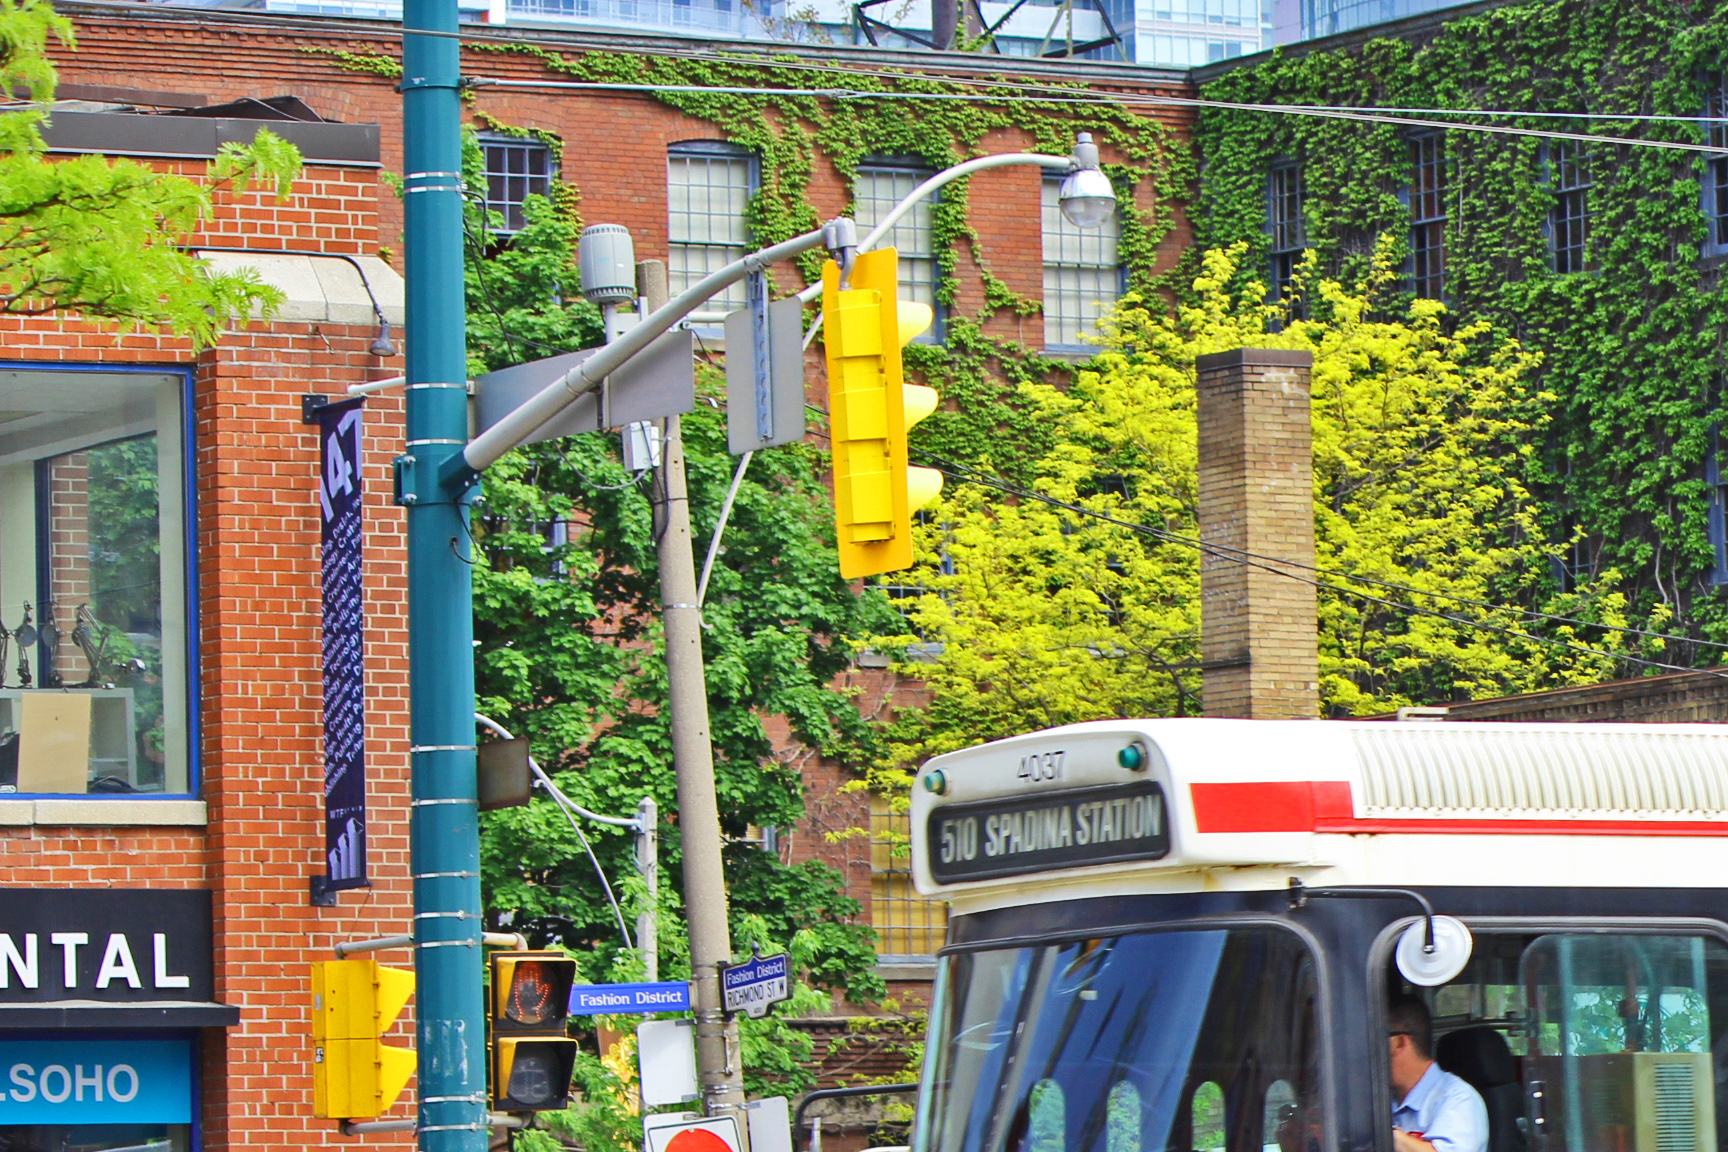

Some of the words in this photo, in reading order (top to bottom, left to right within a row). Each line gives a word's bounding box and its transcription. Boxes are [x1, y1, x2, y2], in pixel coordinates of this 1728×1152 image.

[1016, 750, 1065, 782] 4037
[940, 816, 978, 864] 510
[984, 805, 1072, 857] SPADINA
[1076, 794, 1161, 846] STATION
[727, 970, 755, 986] Fashion
[757, 961, 784, 978] District
[579, 992, 630, 1007] Fashion
[635, 990, 682, 1004] District
[727, 984, 764, 1007] RICHMOND
[767, 981, 775, 998] ST
[778, 979, 785, 995] W
